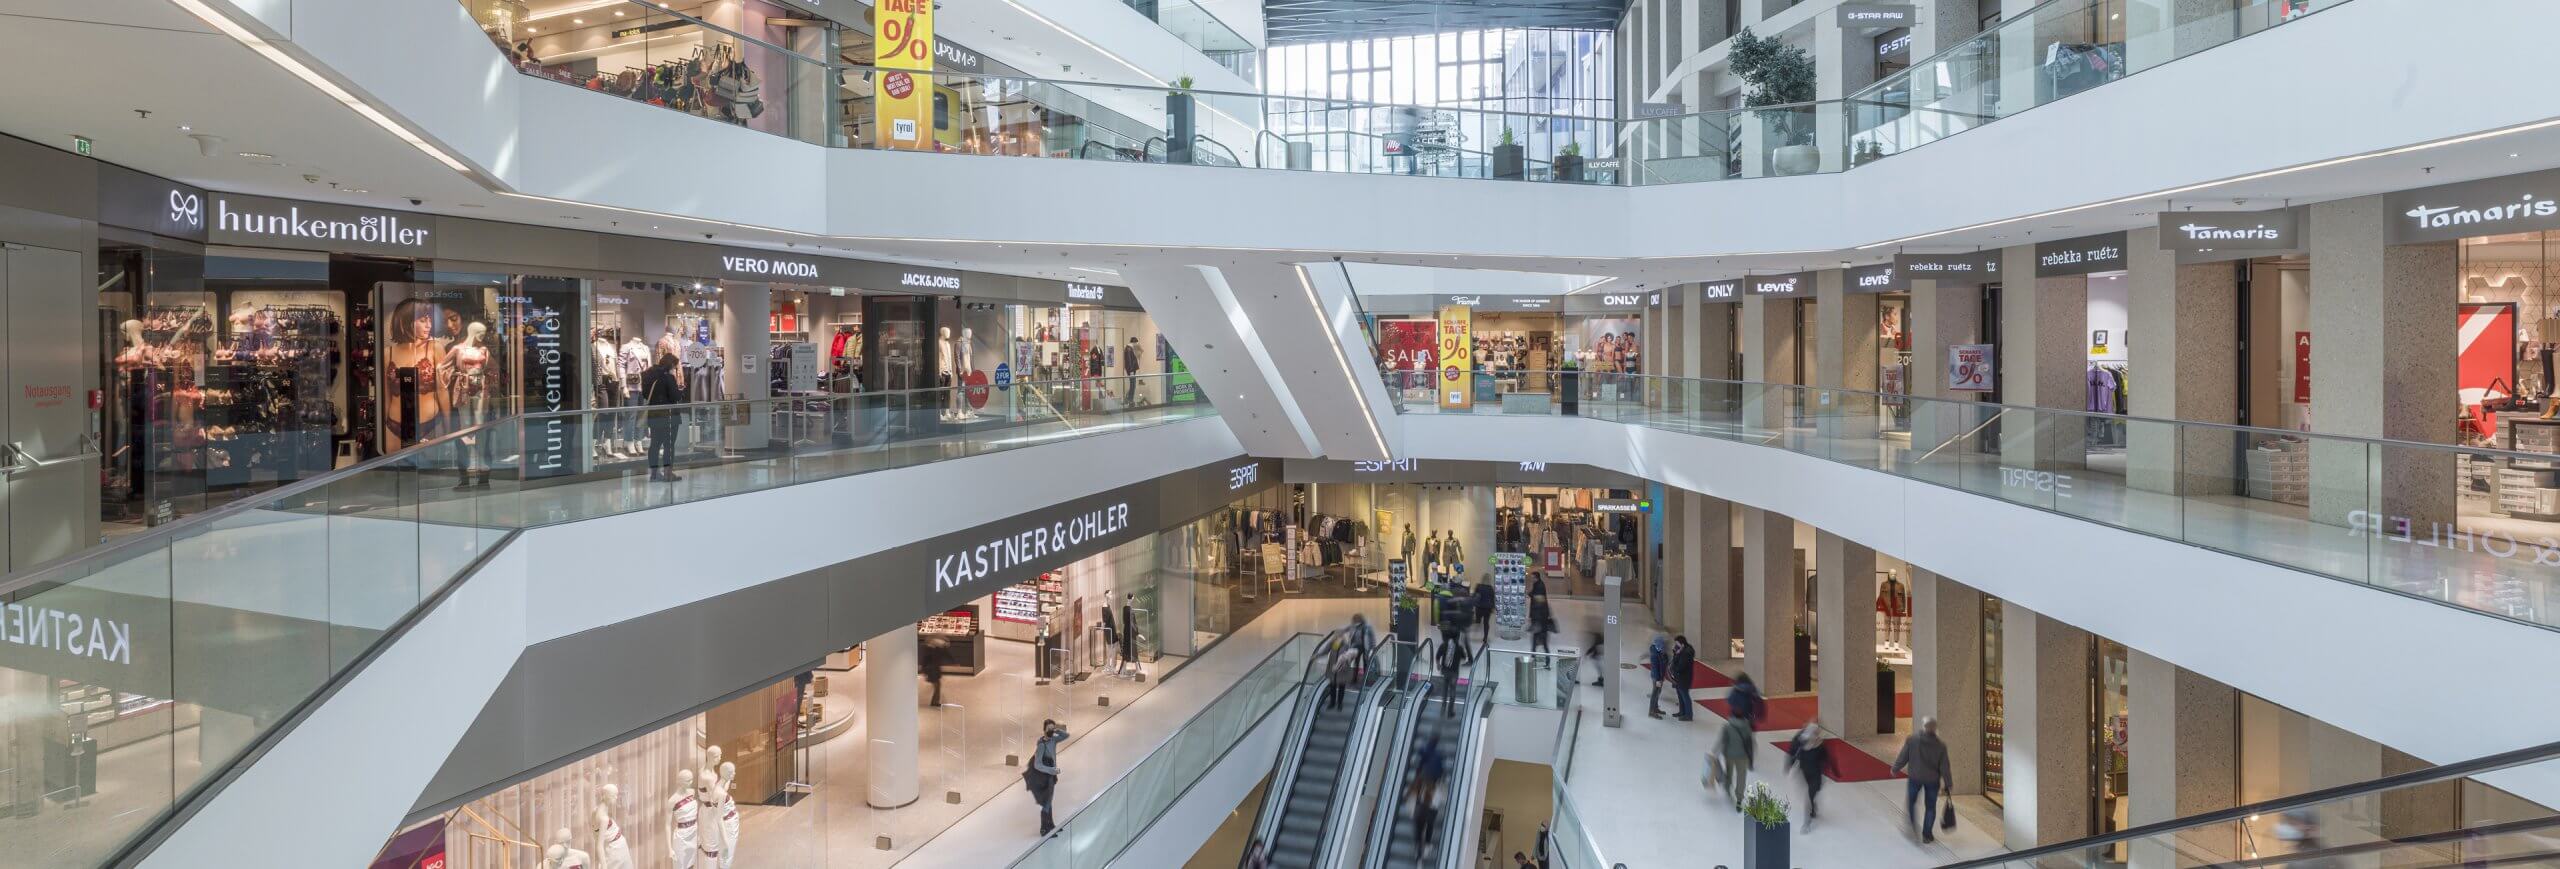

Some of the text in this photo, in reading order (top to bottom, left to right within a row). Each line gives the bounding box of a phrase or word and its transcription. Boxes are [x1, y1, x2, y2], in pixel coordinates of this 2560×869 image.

[896, 122, 913, 133] tyrol
[1588, 161, 1600, 169] ILLY
[2405, 193, 2558, 229] Tamaris
[219, 199, 428, 246] hunkemöller
[2179, 223, 2279, 240] Tamaris
[2042, 246, 2119, 266] rebekka ruétz
[723, 256, 818, 278] VERO MODA
[1909, 262, 1972, 271] rebekka ruétz
[902, 273, 960, 289] JACK&JONES
[1067, 283, 1096, 299] Timberland
[1708, 284, 1733, 298] ONLY
[1604, 296, 1640, 305] ONLY
[1959, 355, 1982, 363] TAGE
[1230, 462, 1259, 490] ESPRIT
[1598, 504, 1631, 512] SPARKASSE
[935, 526, 1047, 593] KASTNER
[1052, 521, 1066, 552] &
[1607, 615, 1617, 625] EG
